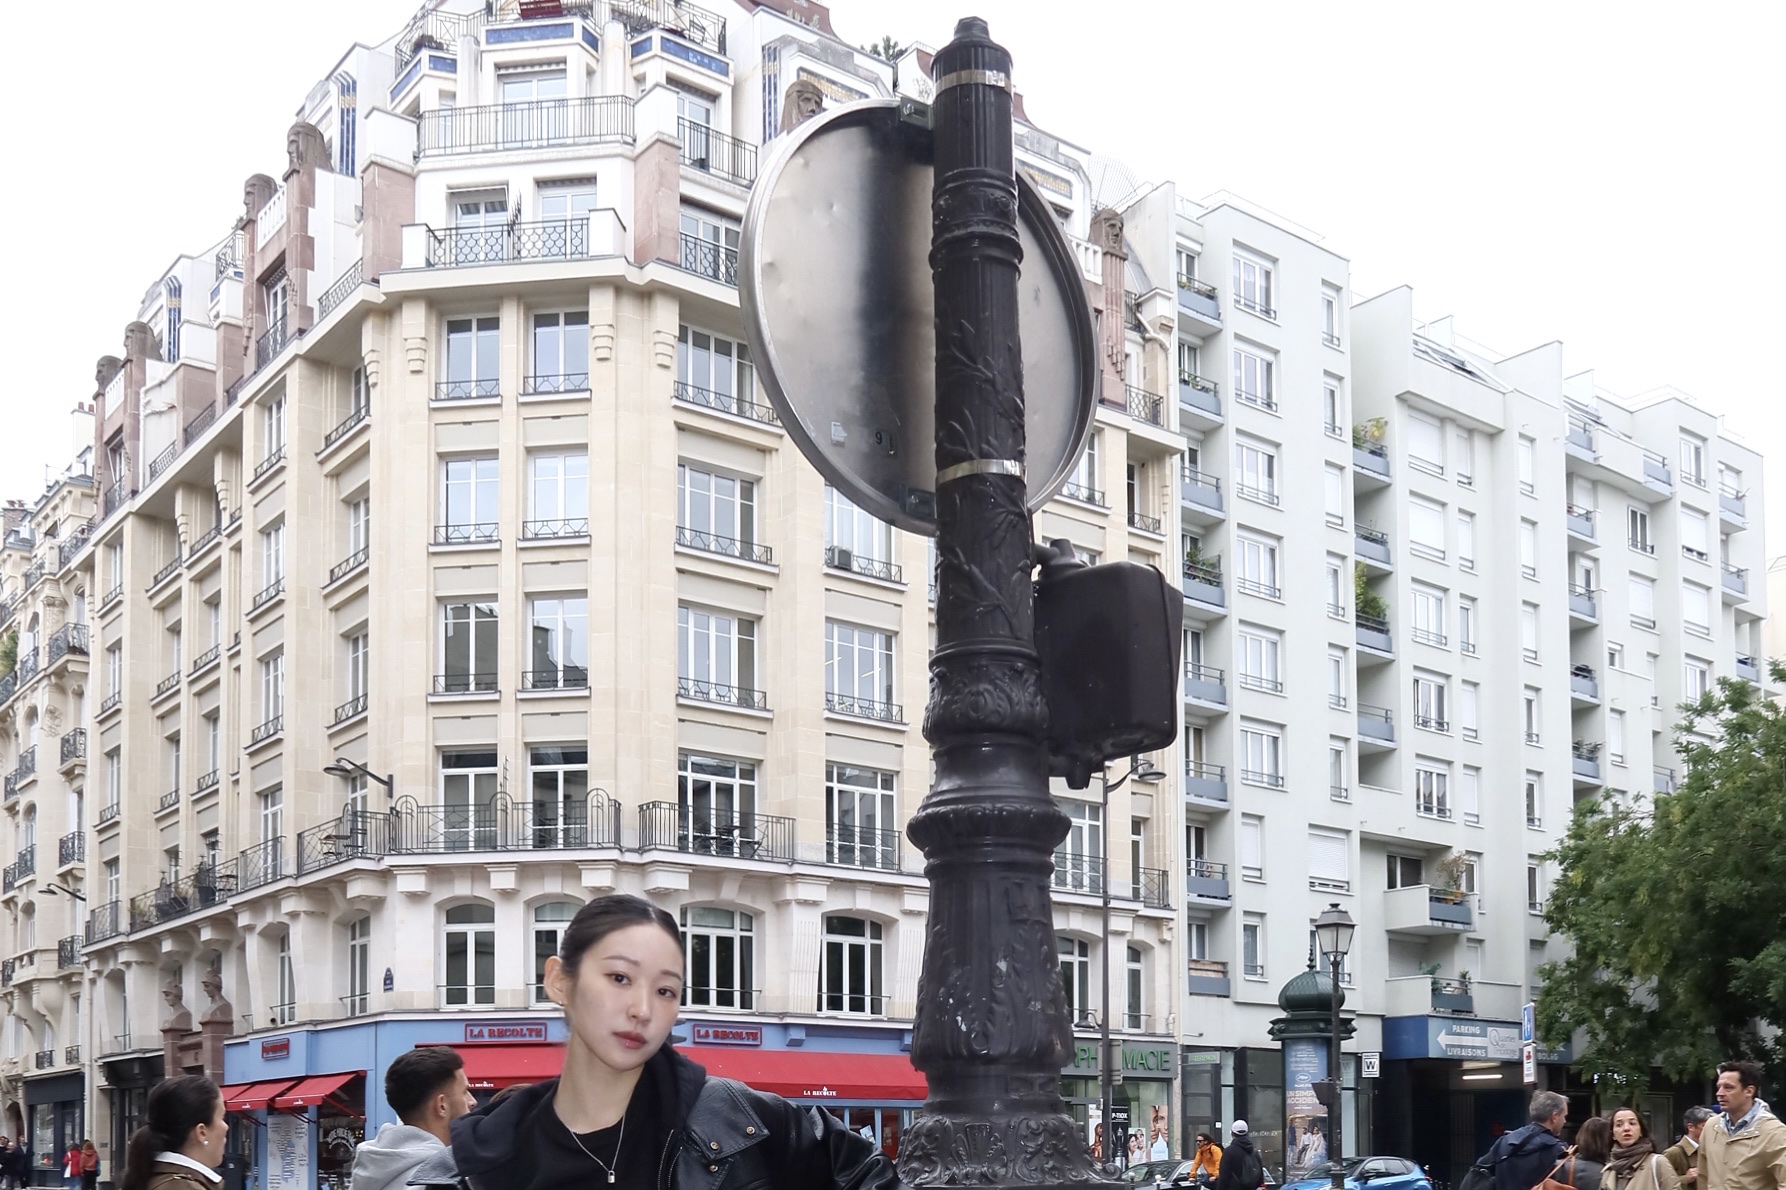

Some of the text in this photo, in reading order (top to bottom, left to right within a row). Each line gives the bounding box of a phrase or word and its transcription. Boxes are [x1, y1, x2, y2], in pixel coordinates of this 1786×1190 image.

[469, 1027, 544, 1039] LA RECOLTE
[696, 1029, 711, 1039] LA
[1452, 1025, 1480, 1035] PARKING
[1446, 1047, 1487, 1057] LIVRAISONS
[1073, 1046, 1171, 1072] PHMACIE
[1365, 1061, 1376, 1070] W
